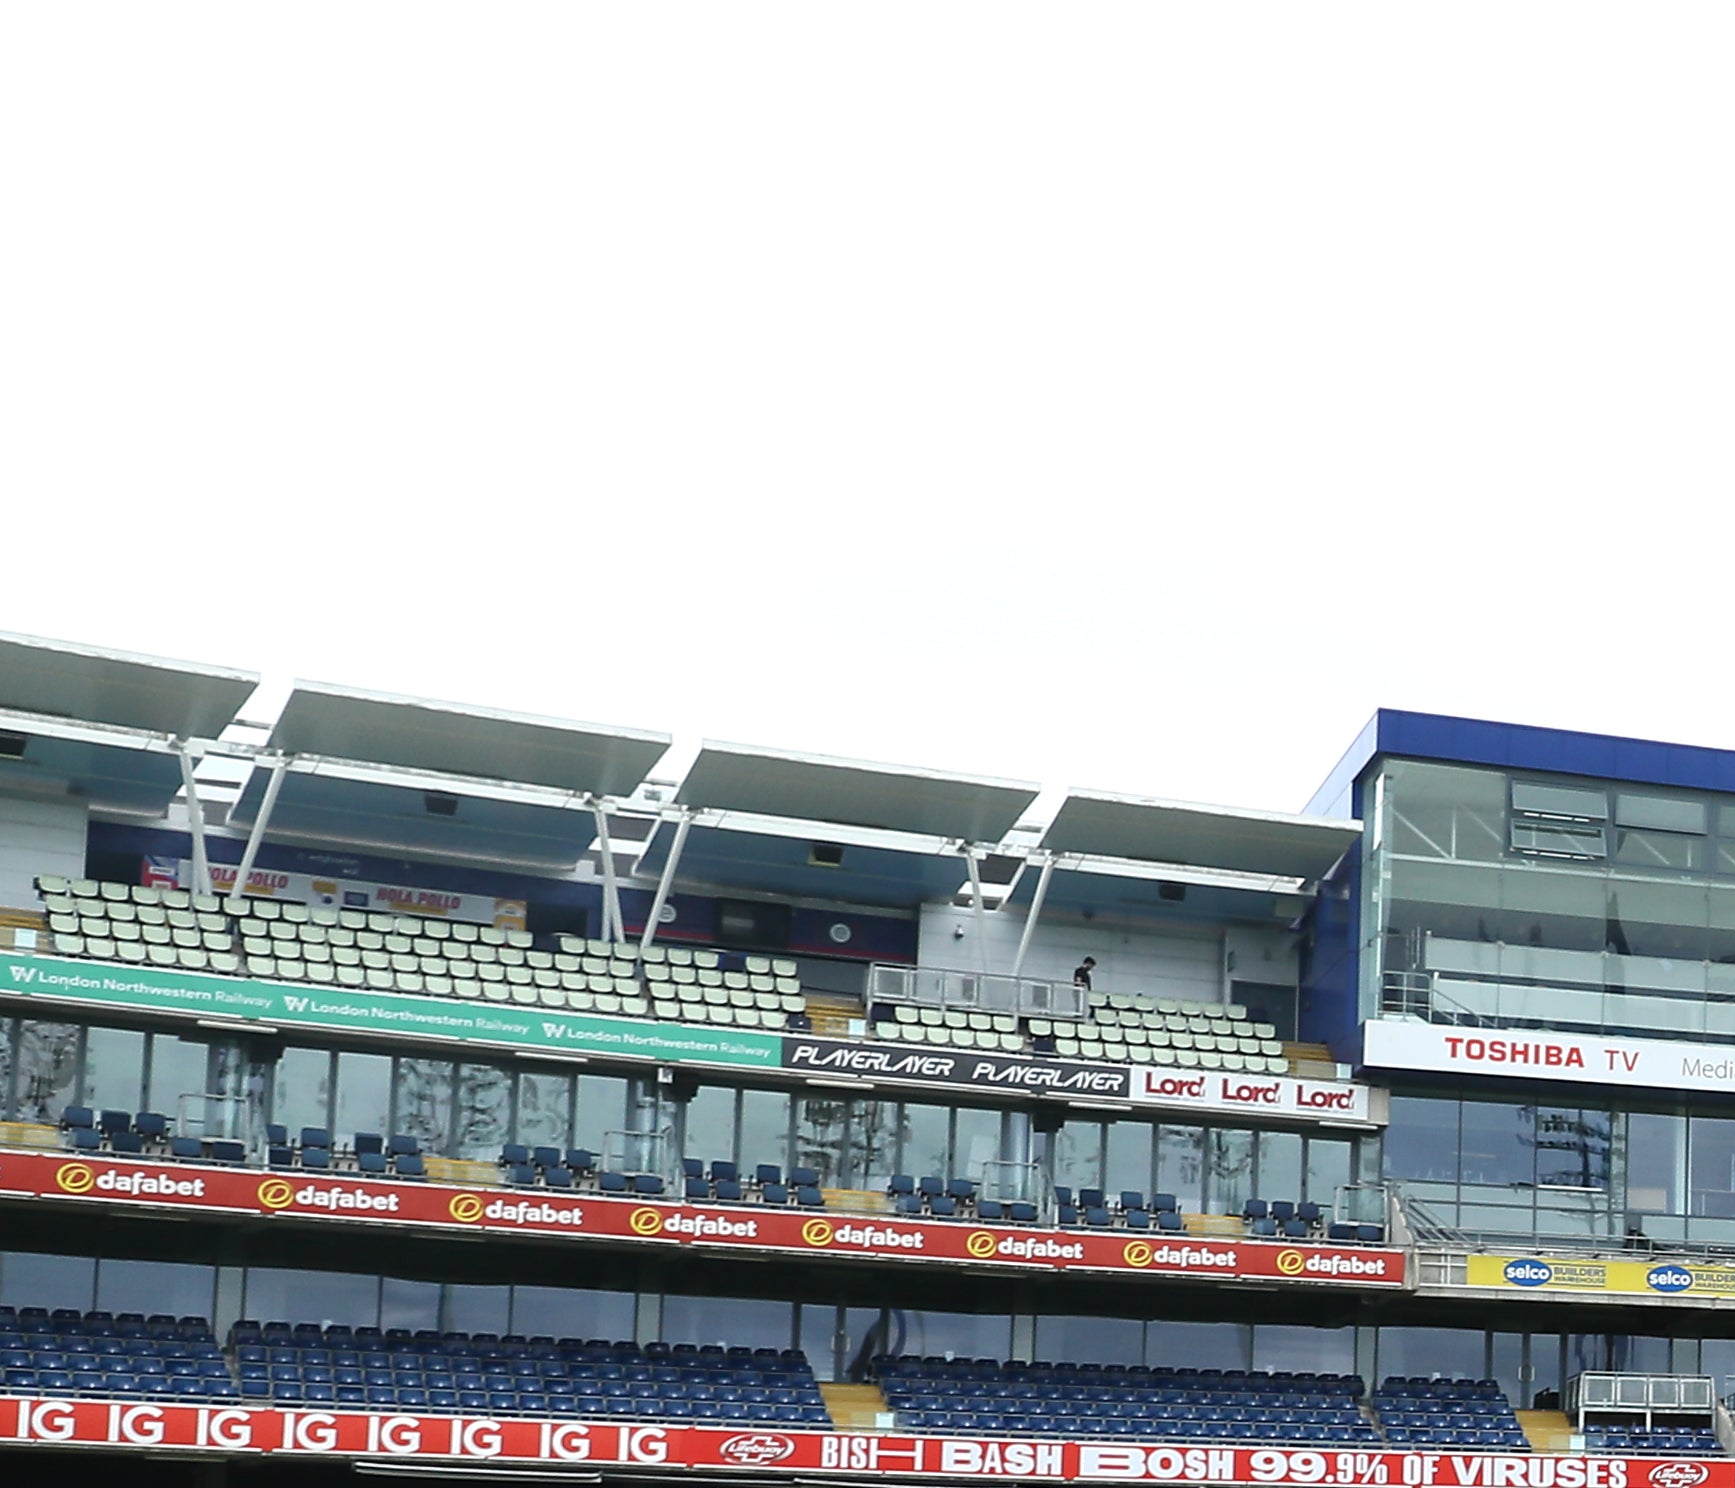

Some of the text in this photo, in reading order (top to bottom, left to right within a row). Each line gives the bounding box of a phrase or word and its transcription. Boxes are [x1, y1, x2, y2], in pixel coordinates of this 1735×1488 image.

[38, 971, 273, 1009] London Northwestern Railway
[310, 1000, 530, 1035] London Northwestern Railway
[566, 1027, 772, 1059] London Northwestern Railway
[1444, 1036, 1585, 1068] TOSHIBA
[1604, 1049, 1640, 1072] TV
[791, 1044, 1127, 1093] PLAYERLAYER PLAYERLAYER
[96, 1169, 205, 1197] dafabet
[295, 1185, 400, 1212] dafabet
[484, 1199, 583, 1225] dafabet
[663, 1213, 758, 1237] dafabet
[834, 1224, 924, 1249] dafabet
[997, 1236, 1084, 1259] dafabet
[1153, 1245, 1237, 1268] dafabet
[1305, 1253, 1386, 1276] dafabet
[1505, 1263, 1551, 1281] selco
[1649, 1270, 1692, 1287] selco
[16, 1398, 75, 1442] IG
[107, 1402, 166, 1446] IG
[198, 1405, 254, 1450] IG
[281, 1409, 338, 1451] IG
[366, 1413, 422, 1456] IG
[450, 1416, 503, 1458] IG
[539, 1421, 591, 1461] IG
[617, 1424, 669, 1464] IG
[728, 1443, 785, 1457] Lifebuoy
[819, 1435, 925, 1473] BISH
[939, 1438, 1064, 1478] BASH
[1079, 1442, 1237, 1482] BOSH
[1247, 1448, 1389, 1486] 99.9%
[1400, 1451, 1440, 1487] OF
